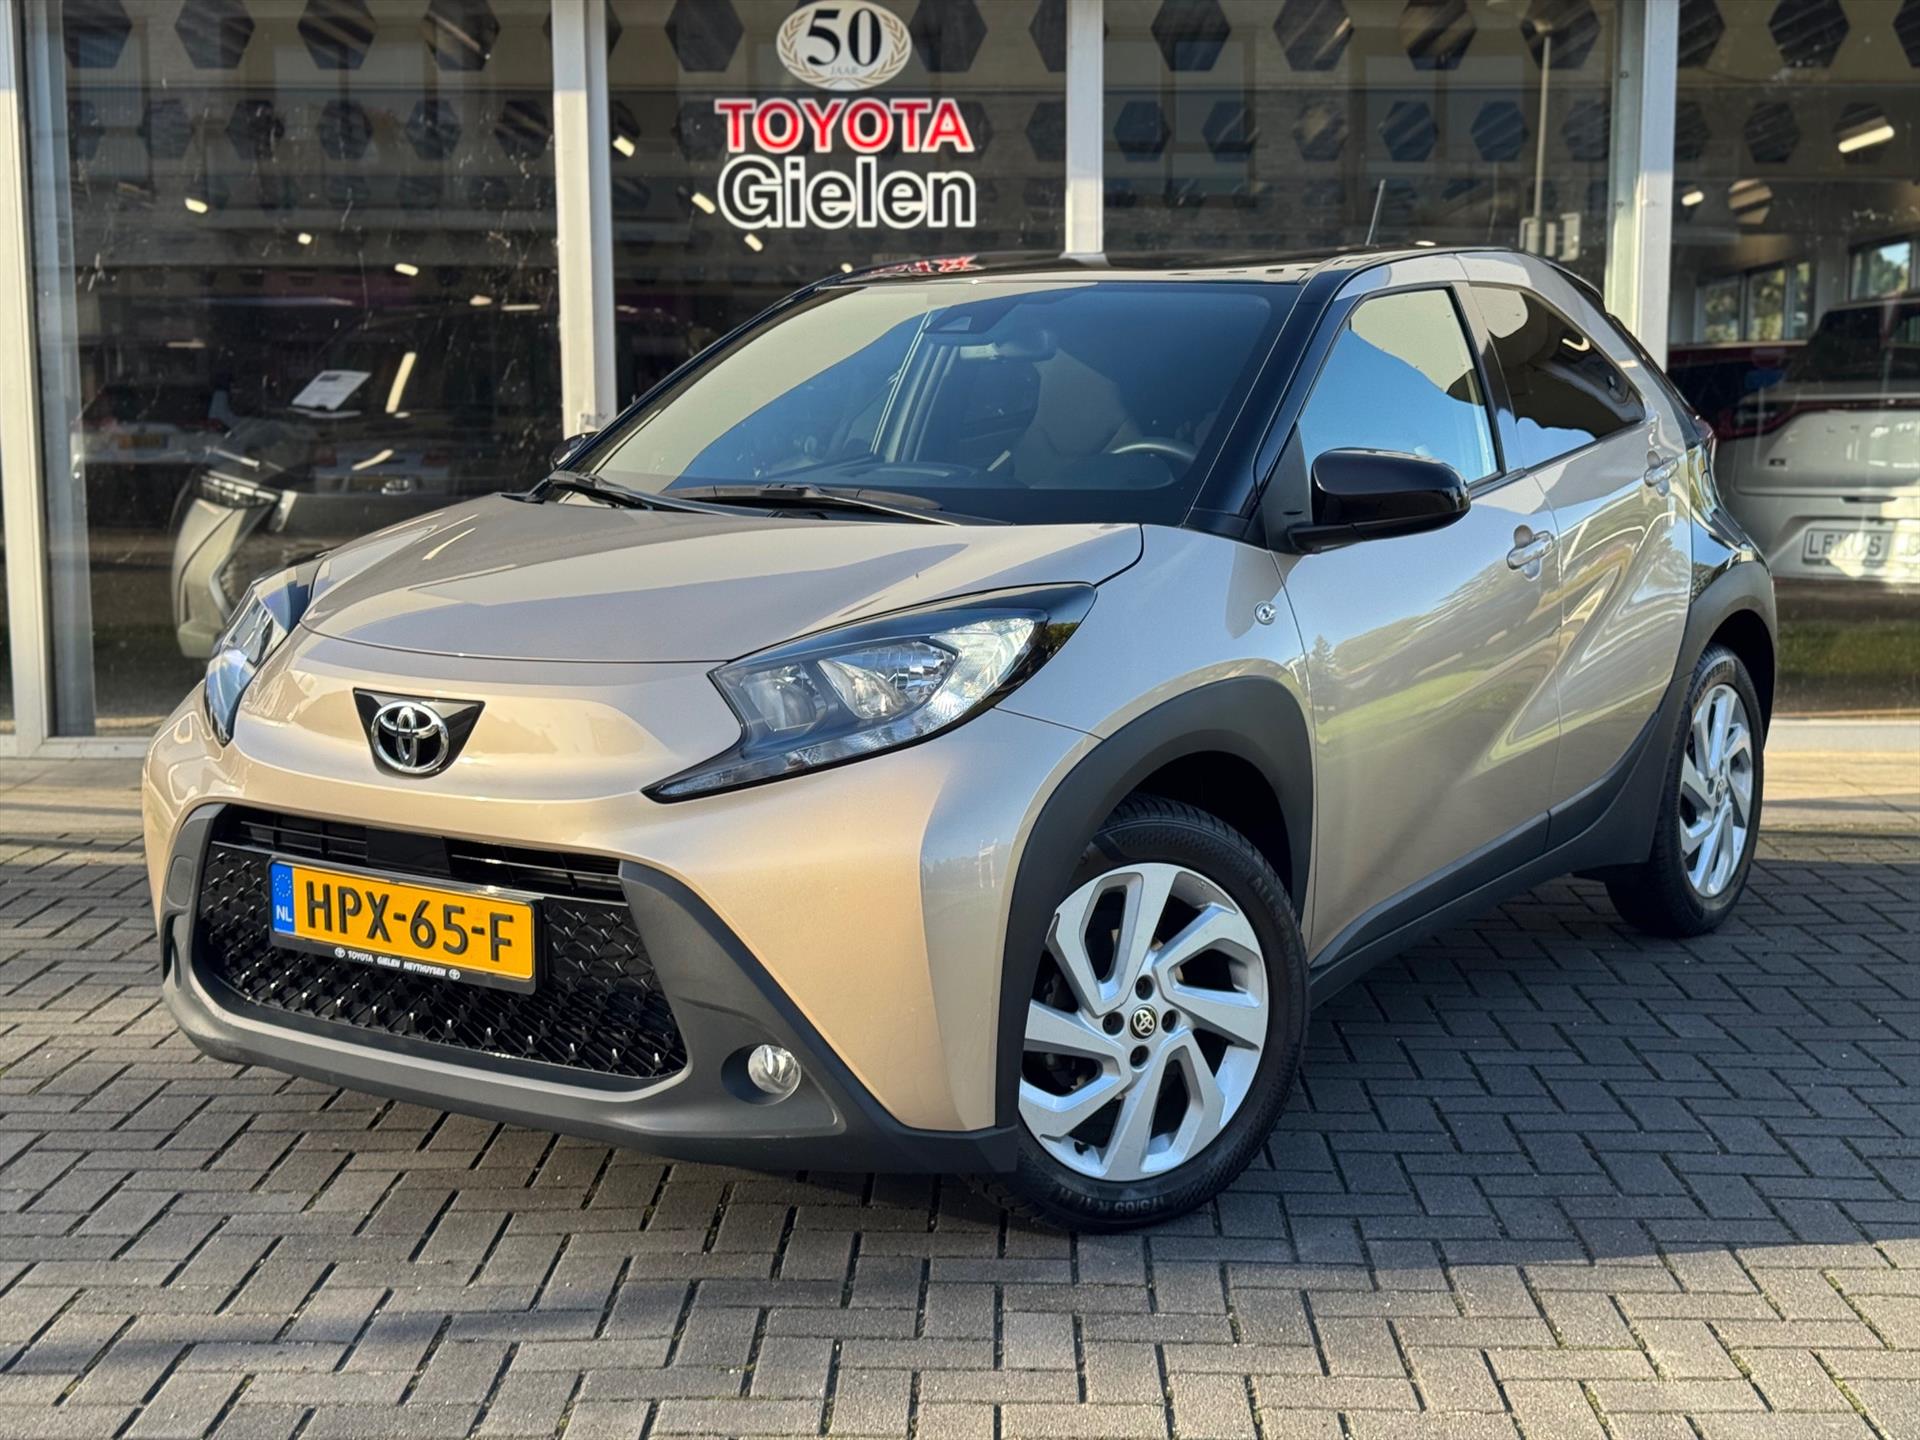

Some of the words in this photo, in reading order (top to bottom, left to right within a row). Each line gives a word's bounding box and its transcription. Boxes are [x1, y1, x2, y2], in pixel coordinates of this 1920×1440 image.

[806, 8, 882, 66] 50
[714, 98, 975, 153] TOYOTA
[717, 154, 976, 229] Gielen
[275, 905, 293, 922] NL
[306, 880, 514, 962] HPX-65-F
[347, 950, 374, 963] TOYOTA
[377, 956, 400, 968] GIELEN
